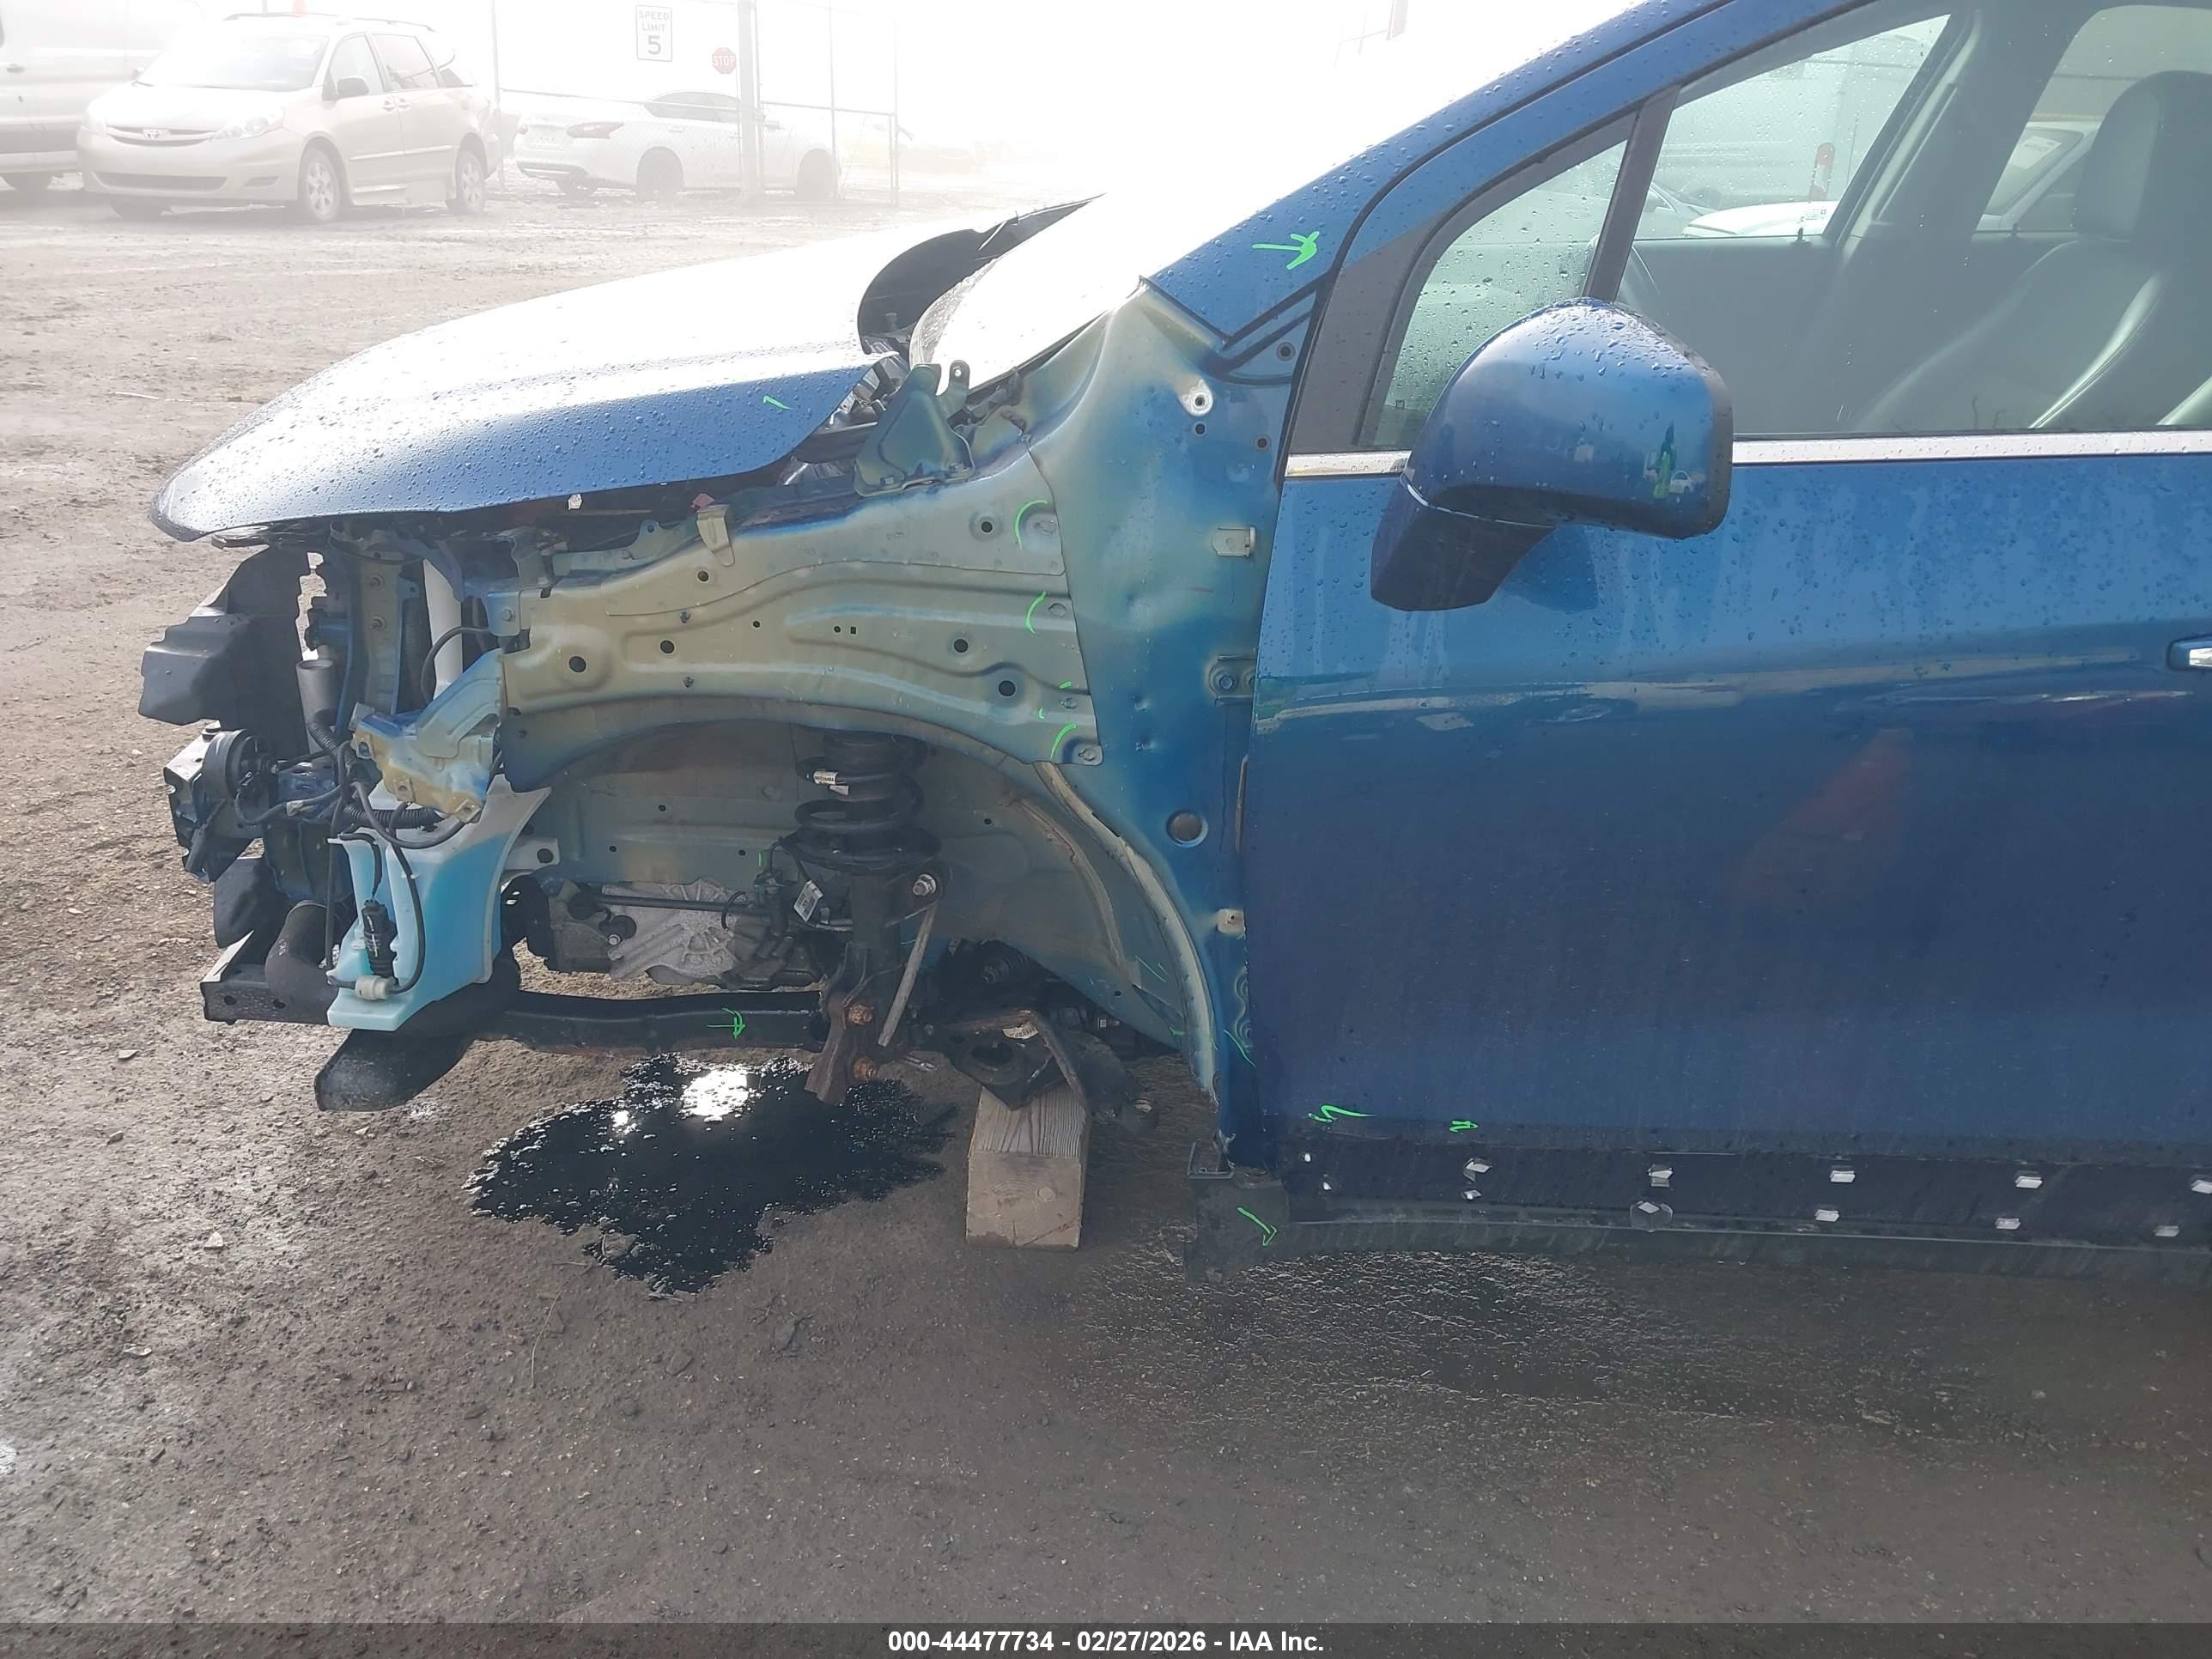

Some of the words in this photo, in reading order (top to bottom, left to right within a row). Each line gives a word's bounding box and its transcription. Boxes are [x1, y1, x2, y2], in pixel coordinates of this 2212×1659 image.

[638, 10, 670, 21] SPEED
[641, 21, 666, 32] LIMIT
[647, 35, 661, 55] 5
[714, 54, 736, 67] STOP
